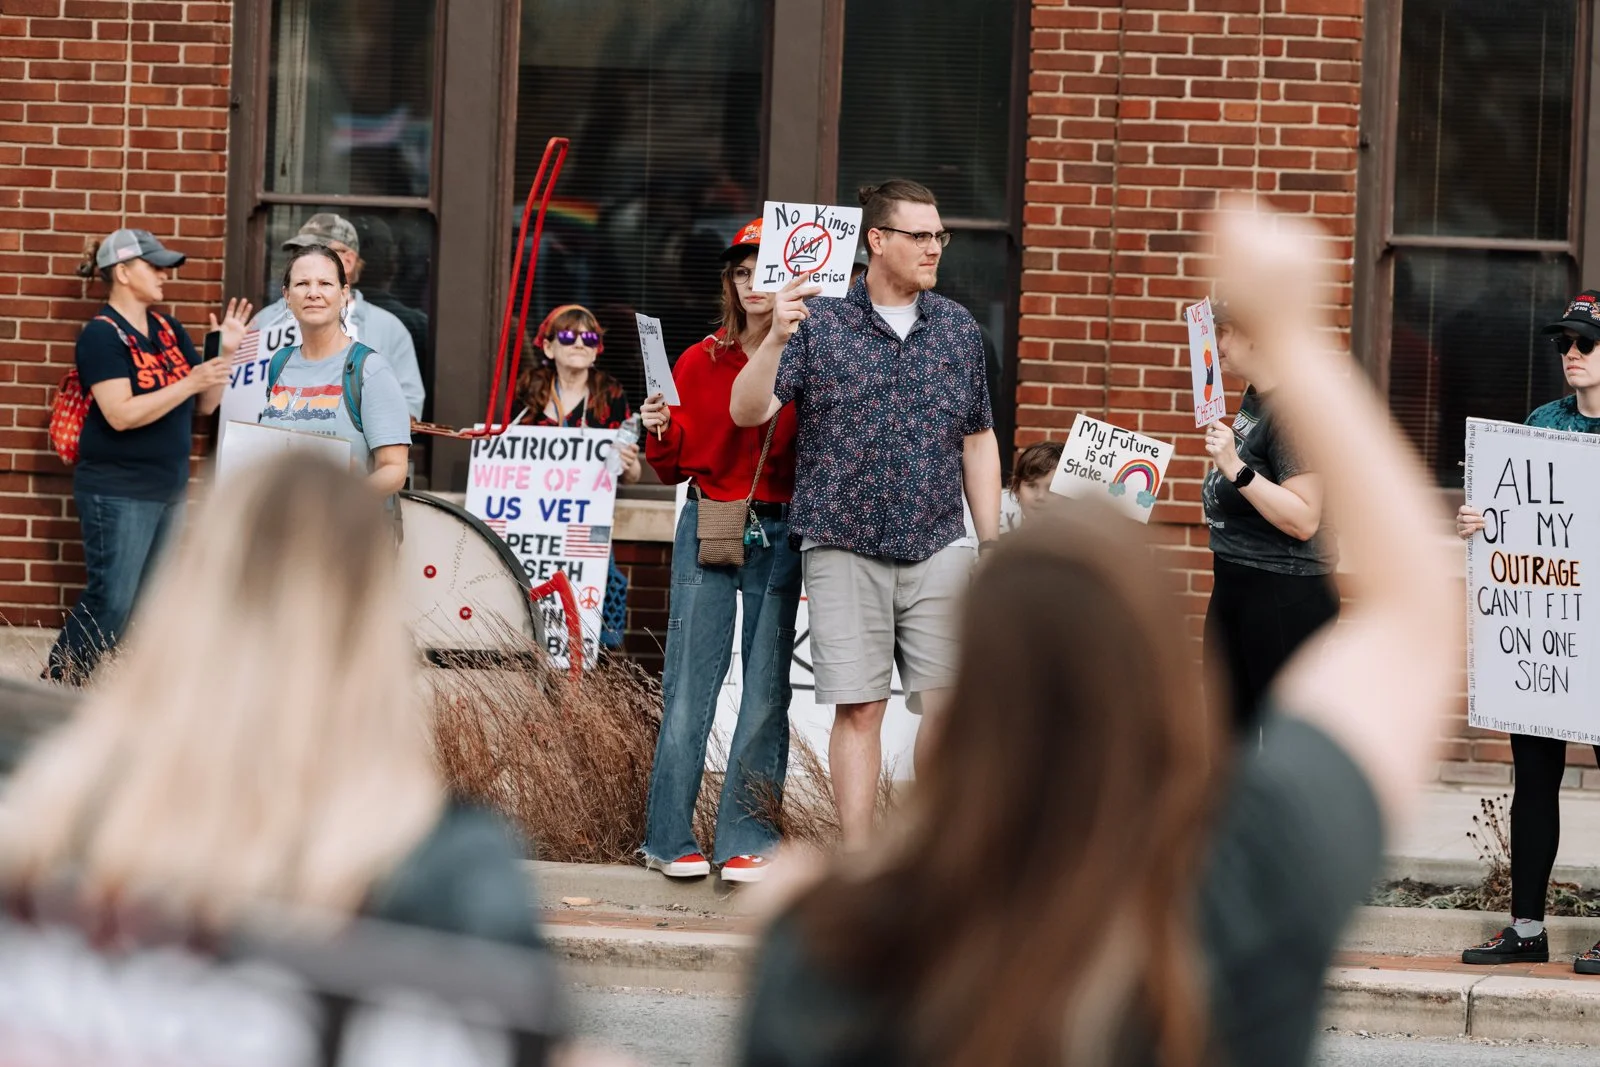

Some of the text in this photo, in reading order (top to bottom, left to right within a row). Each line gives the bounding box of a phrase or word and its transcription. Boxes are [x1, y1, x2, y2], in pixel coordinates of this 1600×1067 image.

[775, 203, 857, 240] No Kings
[763, 264, 846, 284] In Aerica
[267, 326, 296, 352] US
[229, 359, 270, 389] VET
[1196, 396, 1223, 425] CHEETO
[473, 436, 613, 462] PATRIOTIC
[1078, 420, 1160, 458] My Future
[1085, 446, 1117, 468] is at
[474, 464, 613, 492] WIFE OF A
[1494, 457, 1564, 505] ALL
[485, 495, 591, 523] US VET
[1482, 507, 1574, 548] OF MY
[507, 533, 562, 556] PETE
[1491, 550, 1581, 587] OUTRAGE
[1477, 586, 1583, 621] CAN'T FIT
[1500, 625, 1579, 658] ON ONE
[1515, 660, 1570, 694] SIGN
